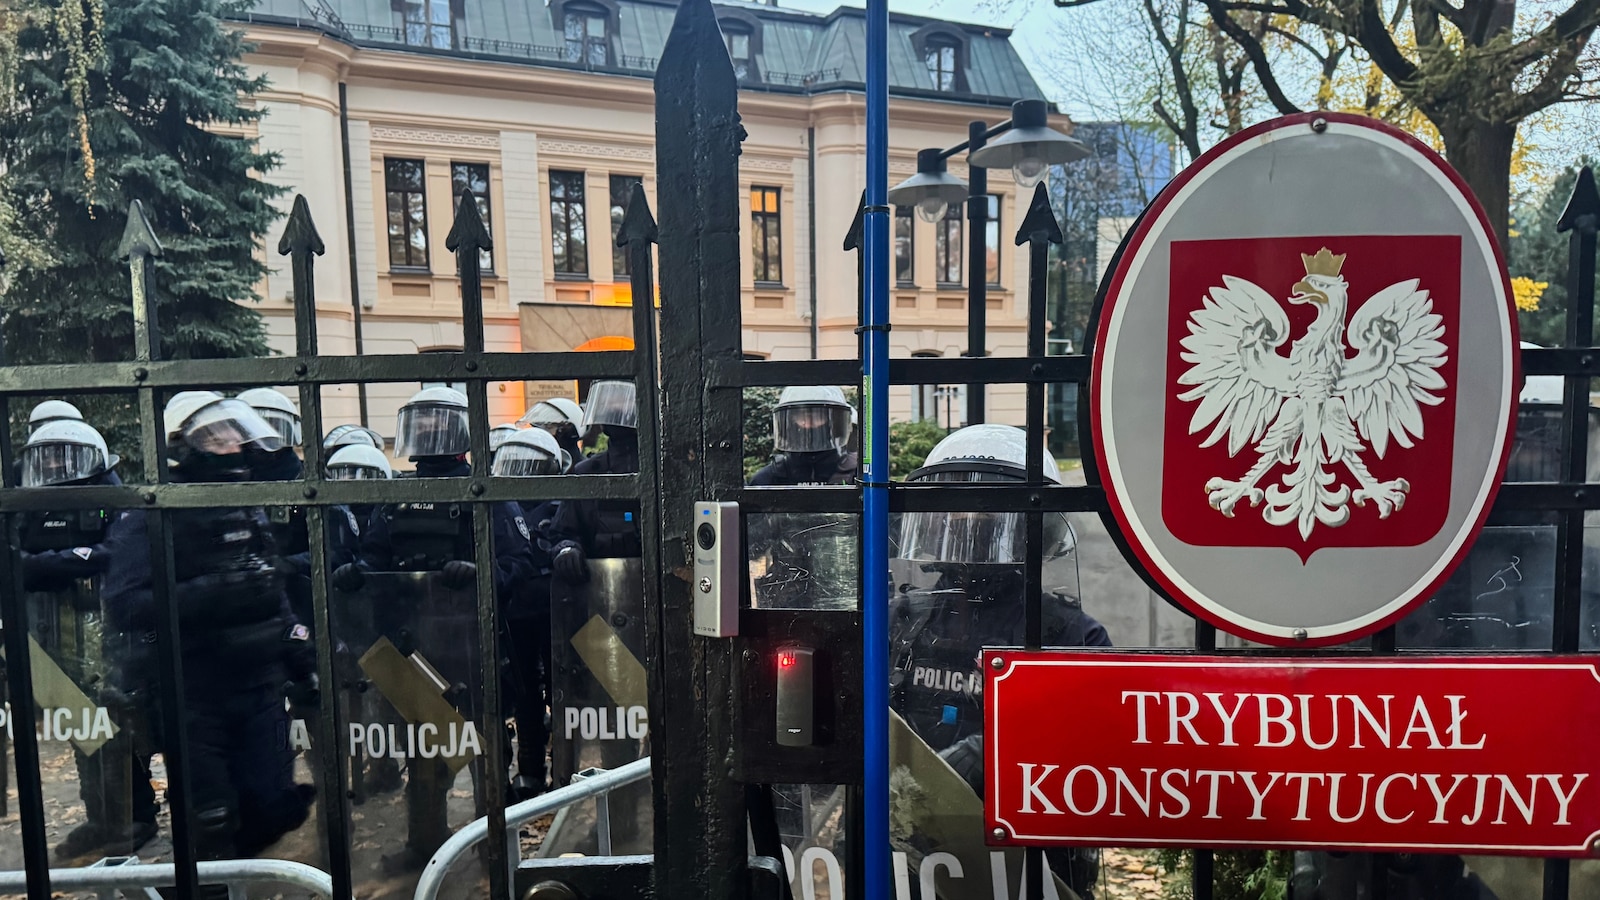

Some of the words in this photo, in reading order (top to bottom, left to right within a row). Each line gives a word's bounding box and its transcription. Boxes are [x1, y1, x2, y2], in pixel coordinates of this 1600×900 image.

[348, 720, 482, 759] POLICJA
[1121, 690, 1487, 750] TRYBUNAŁ
[1016, 762, 1589, 826] KONSTYTUCYJNY
